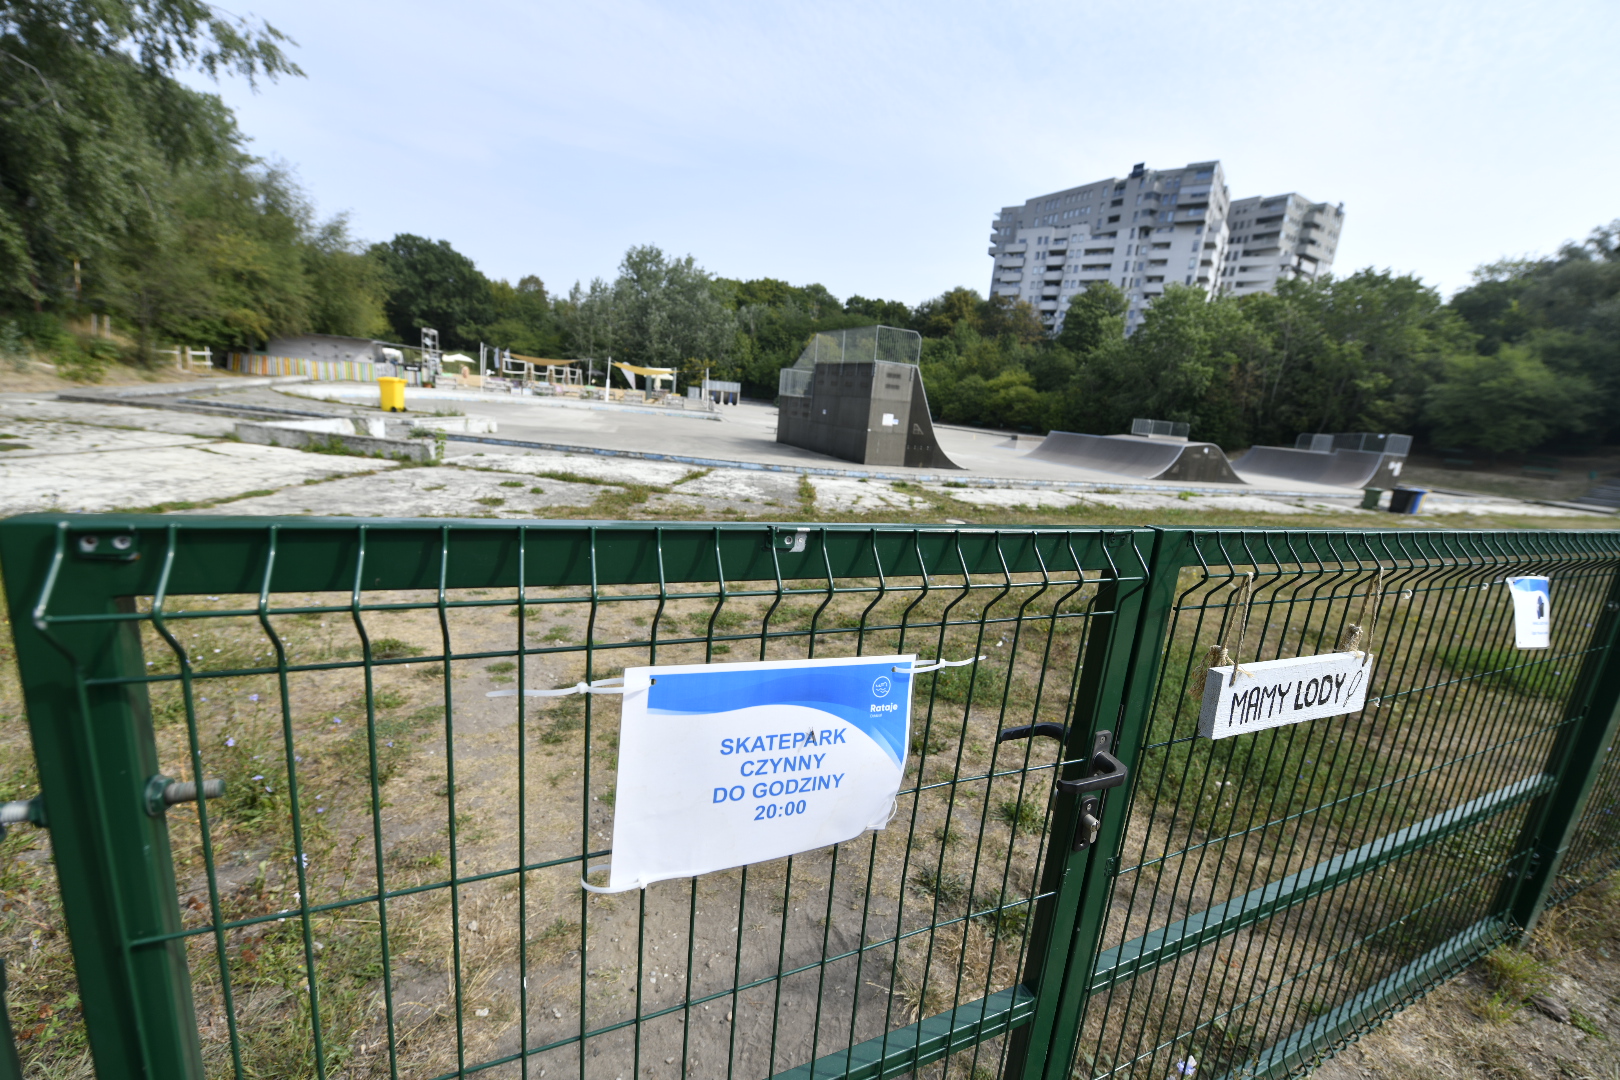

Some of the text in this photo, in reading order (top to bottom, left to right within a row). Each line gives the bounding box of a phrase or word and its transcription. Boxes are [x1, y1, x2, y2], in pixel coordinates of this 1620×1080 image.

[870, 702, 898, 713] Rataje
[1228, 672, 1347, 727] MAMY LODY
[720, 728, 847, 755] SKATEPARK
[740, 753, 827, 777] CZYNNY
[712, 773, 845, 804] DO GODZINY
[753, 800, 807, 821] 20:00
